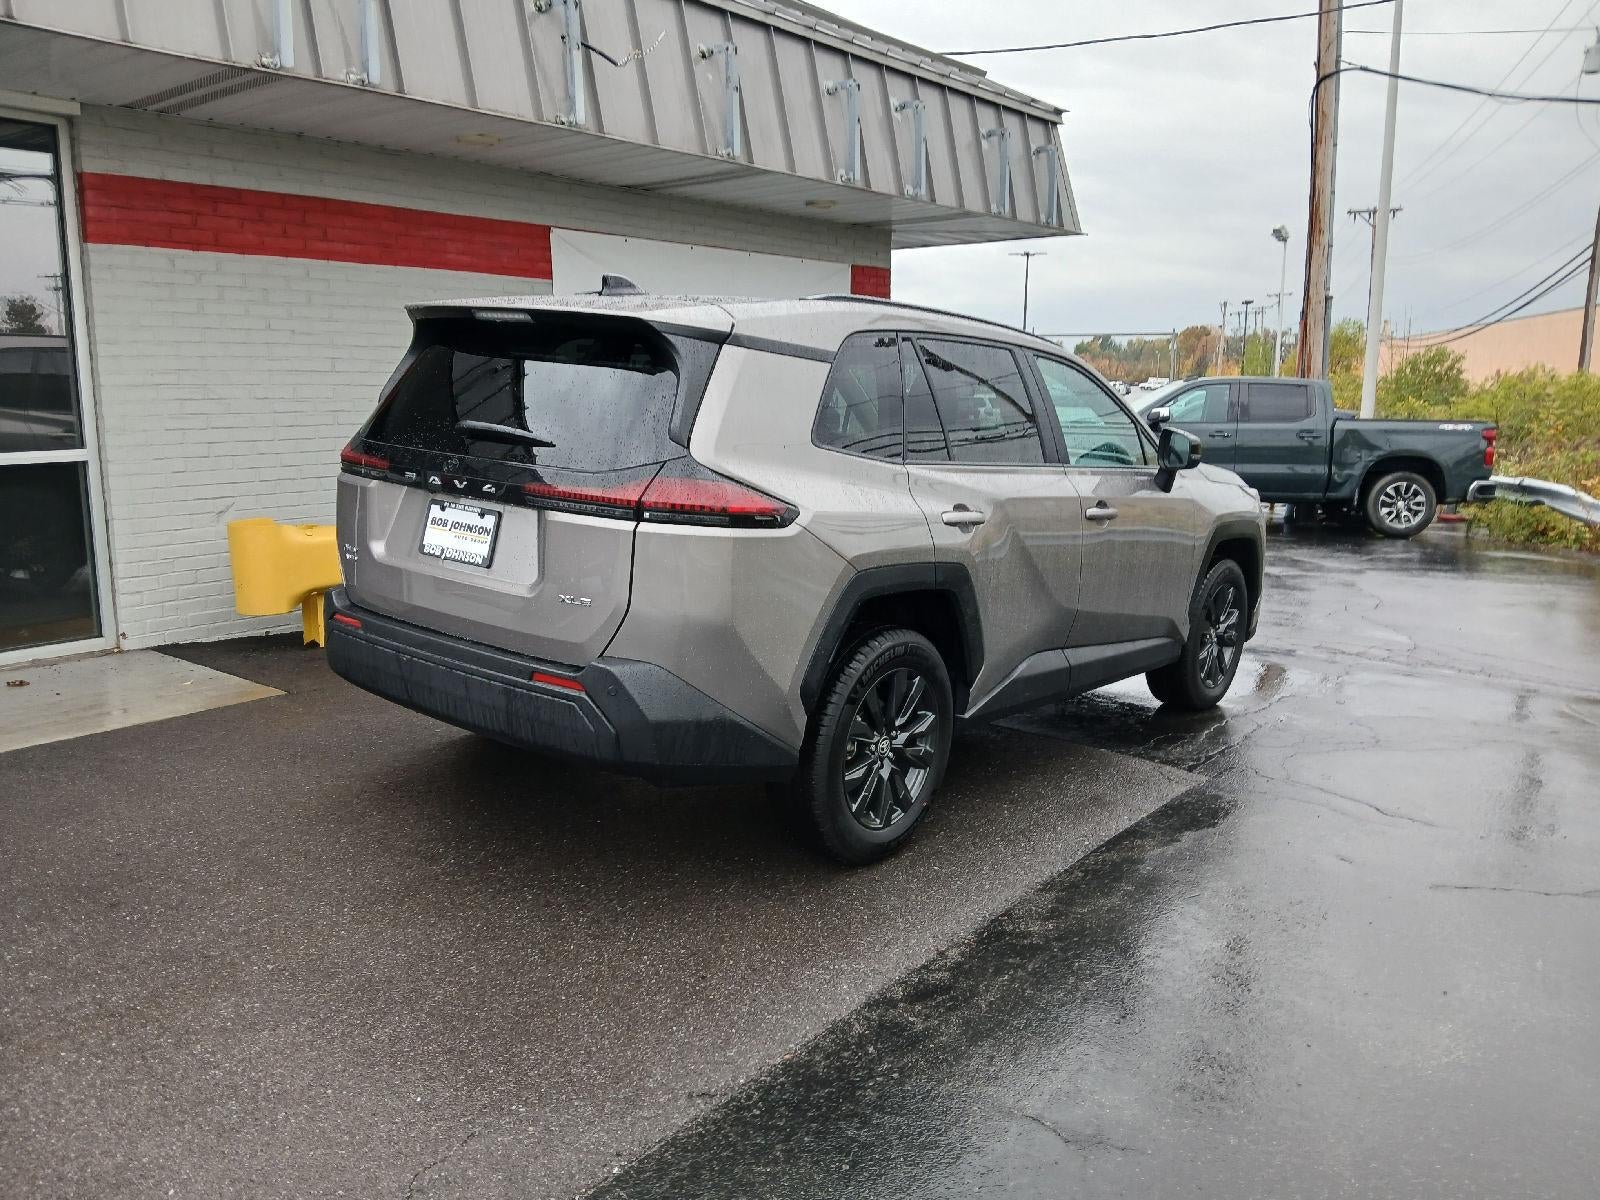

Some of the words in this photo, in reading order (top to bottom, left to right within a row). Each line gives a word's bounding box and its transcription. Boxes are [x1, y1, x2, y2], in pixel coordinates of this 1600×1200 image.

[430, 516, 449, 528] BOB
[448, 520, 492, 537] JOHNSON
[423, 542, 442, 556] BOB
[441, 546, 484, 565] JOHNSON
